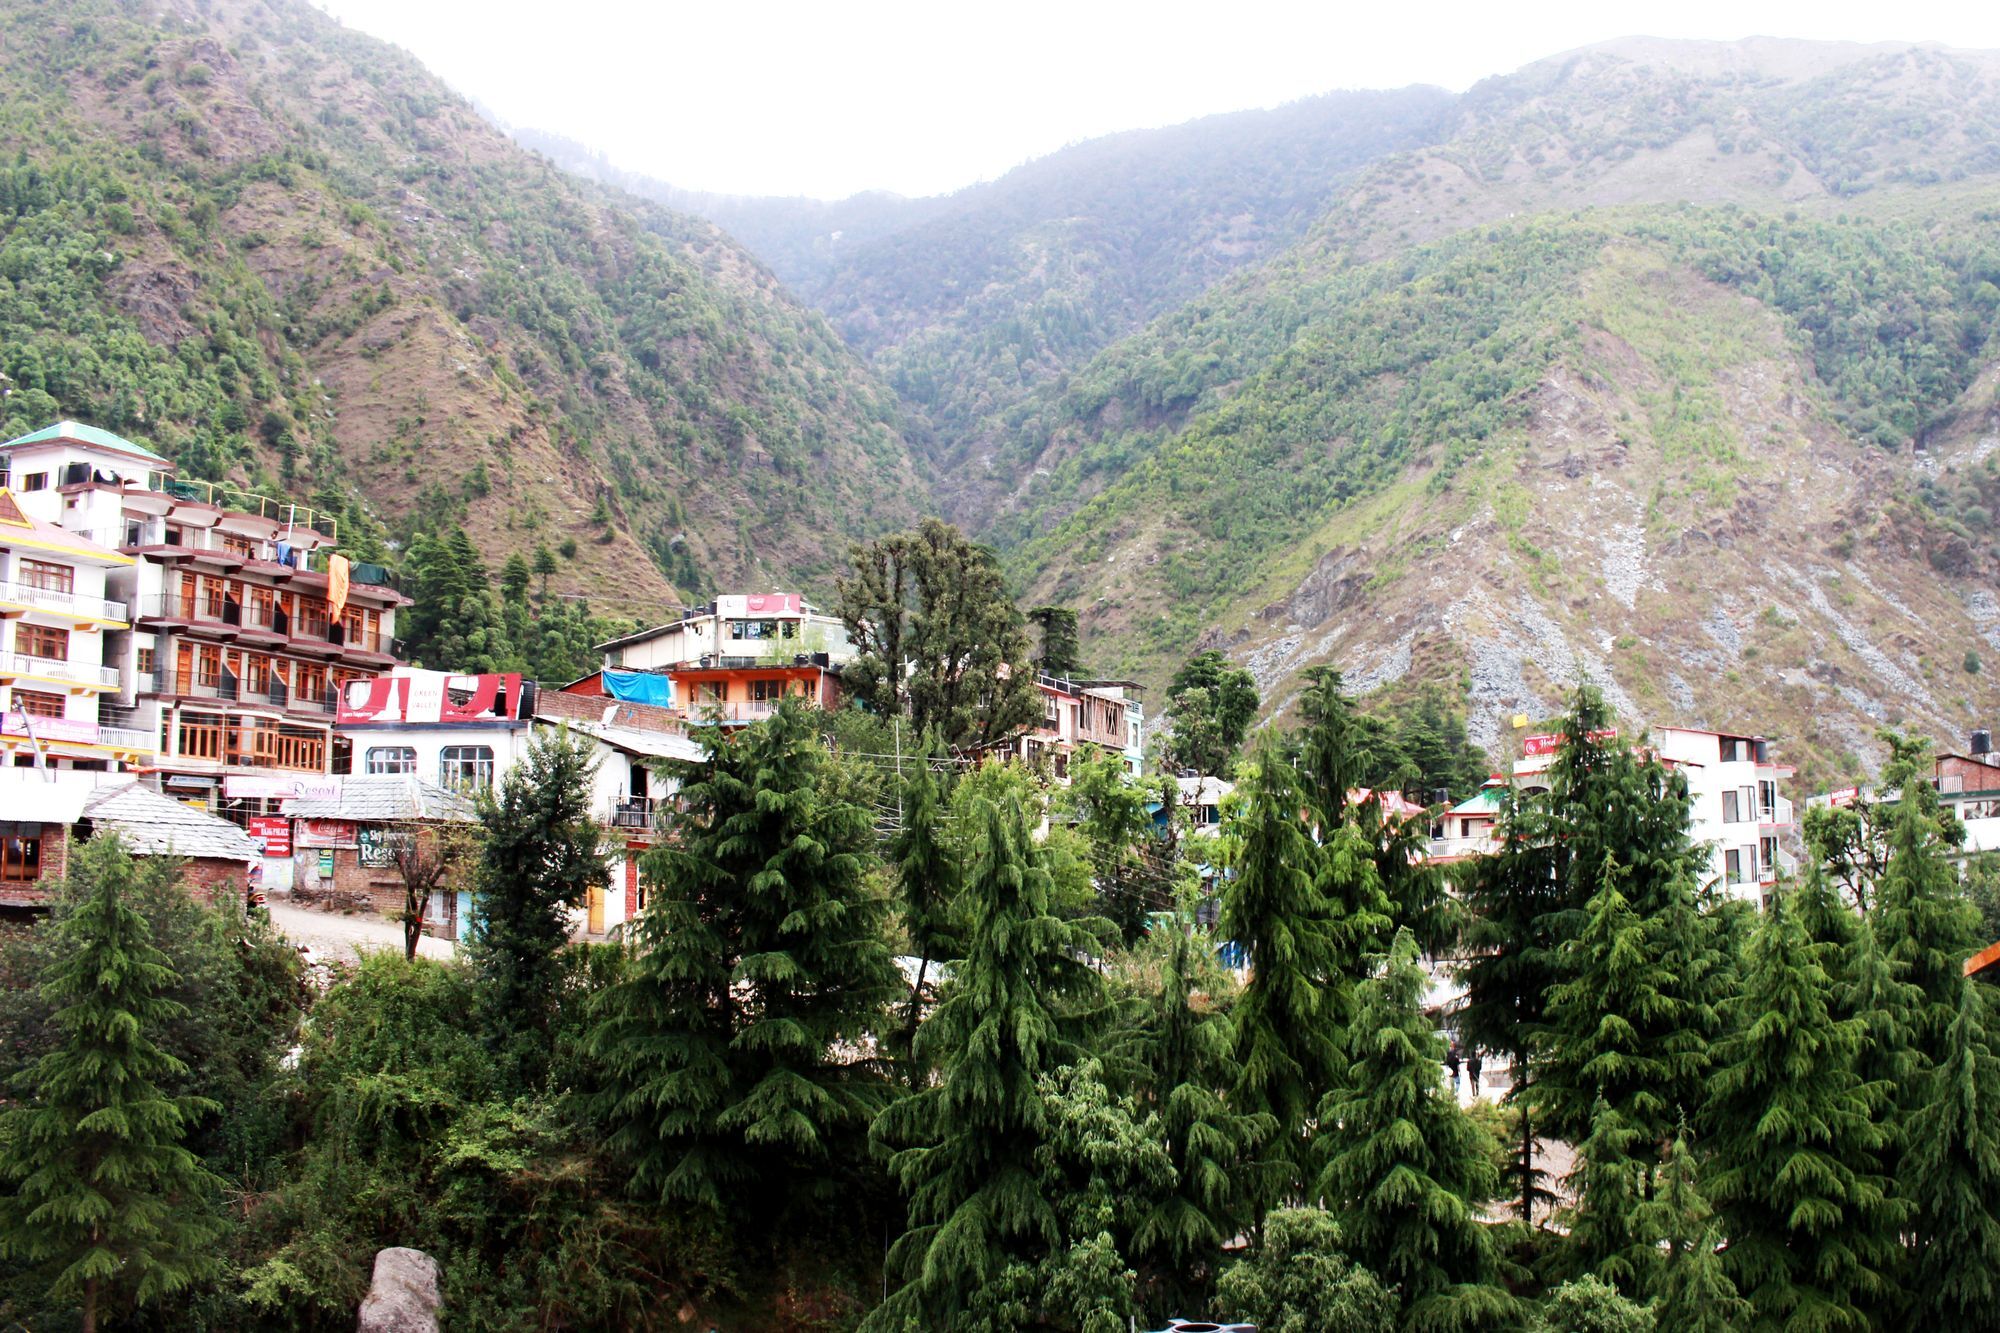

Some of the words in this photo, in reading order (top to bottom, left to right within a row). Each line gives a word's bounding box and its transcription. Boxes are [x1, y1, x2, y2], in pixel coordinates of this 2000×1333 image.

[414, 689, 438, 697] GREEN
[292, 781, 336, 796] Resort
[370, 829, 382, 843] Sky
[361, 843, 412, 861] Resot
